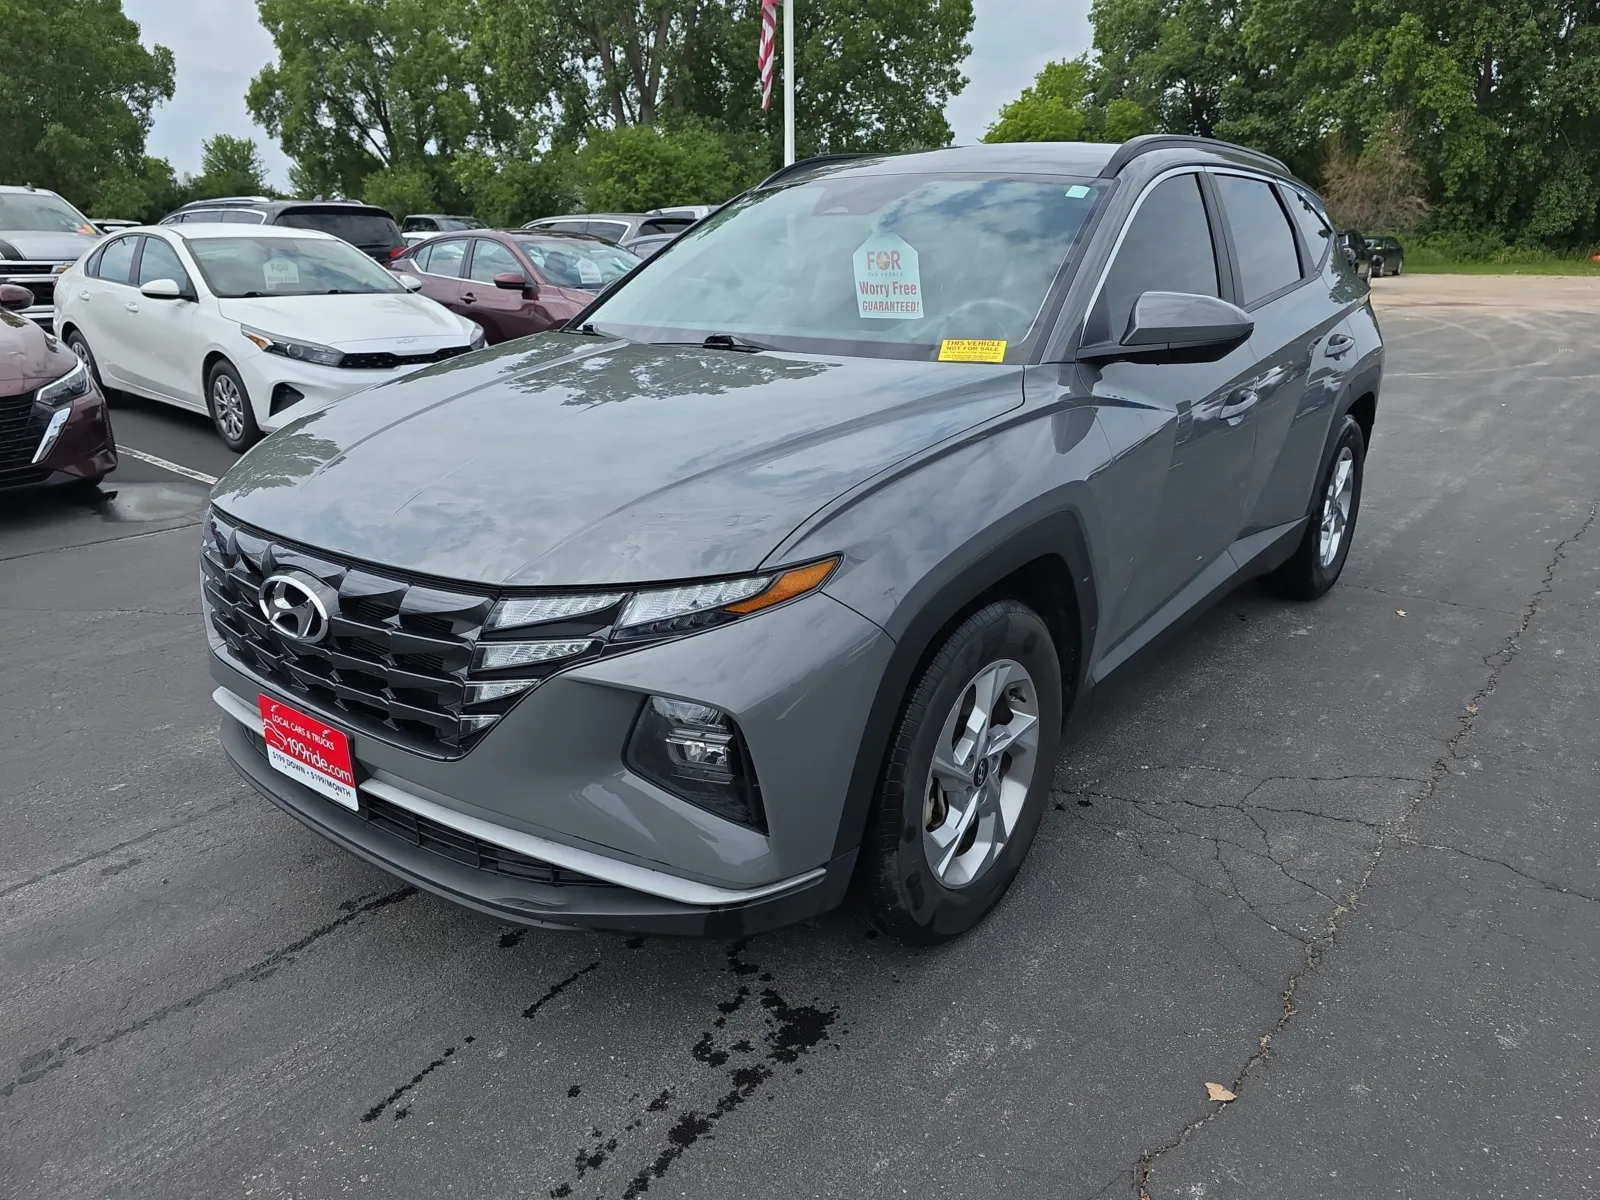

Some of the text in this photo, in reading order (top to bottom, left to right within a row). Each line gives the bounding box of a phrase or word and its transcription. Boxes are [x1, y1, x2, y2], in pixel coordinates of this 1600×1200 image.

[867, 250, 902, 271] FOR
[859, 281, 917, 298] Worry Free
[862, 300, 920, 312] GUARANTEED!
[271, 713, 335, 751] LOCAL CARS & TRUCKS
[272, 751, 285, 764] $199
[286, 758, 306, 775] DOWN
